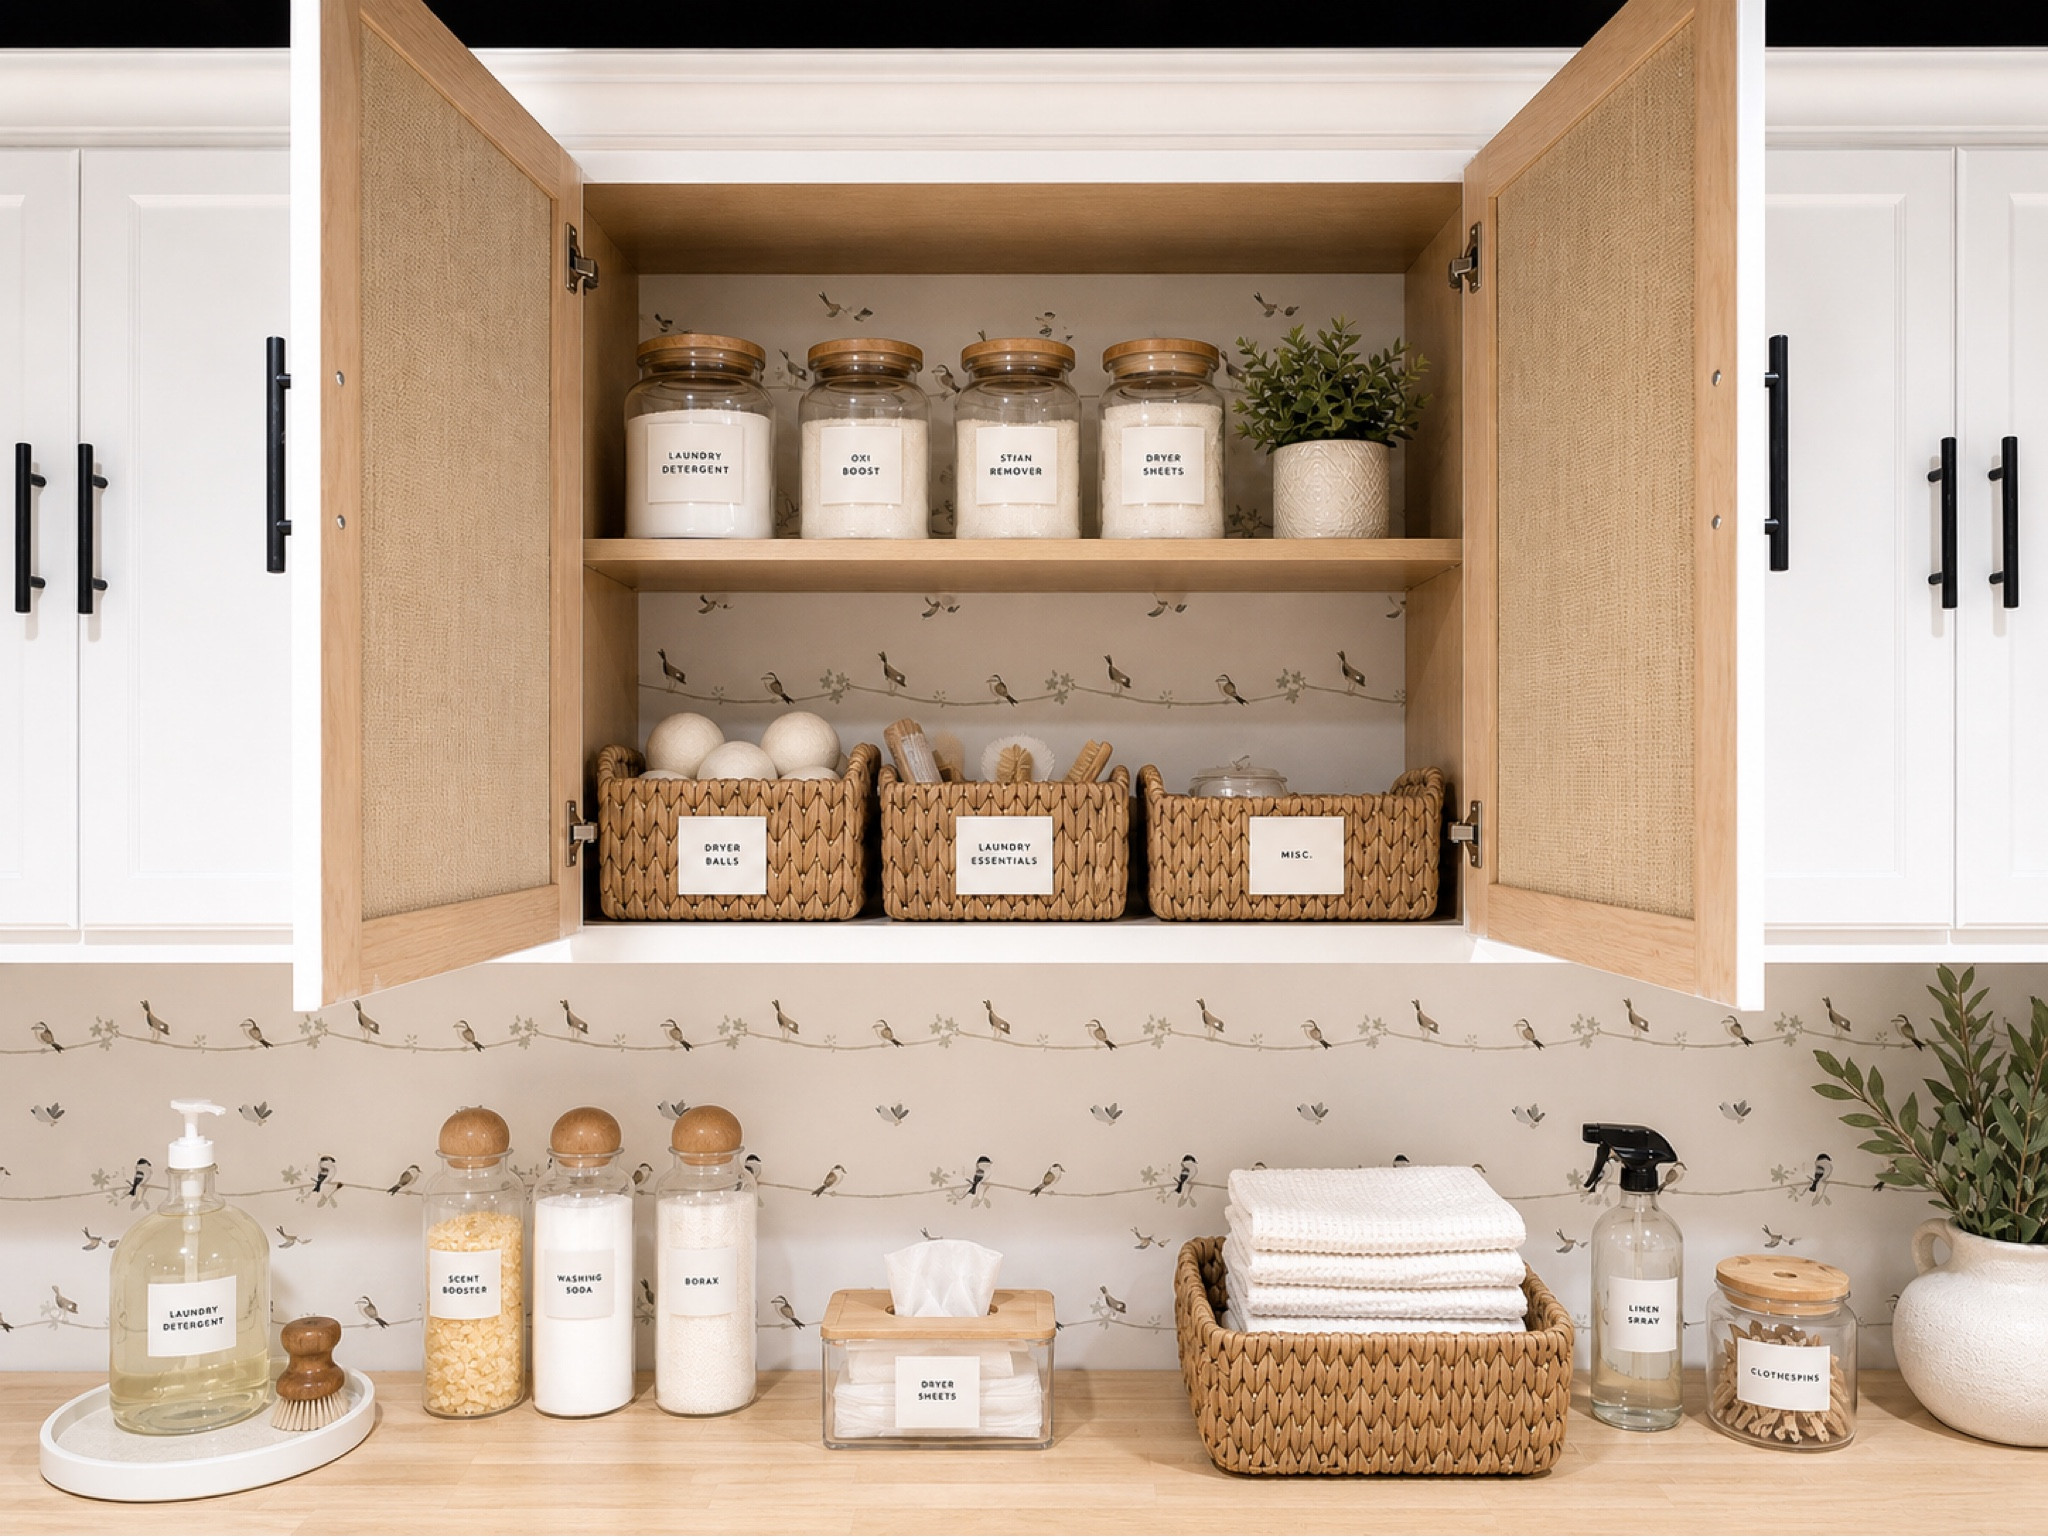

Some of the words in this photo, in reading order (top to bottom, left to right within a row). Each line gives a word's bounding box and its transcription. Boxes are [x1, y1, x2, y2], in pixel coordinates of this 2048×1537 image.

[668, 450, 722, 461] LAUNDRY
[850, 453, 872, 463] OXI
[1000, 453, 1032, 463] STIAN
[1145, 453, 1182, 463] DRYER
[661, 464, 729, 475] DETERGENT
[842, 466, 881, 476] BOOST
[989, 466, 1042, 476] REMOVER
[1143, 466, 1185, 476] SHEETS
[703, 843, 741, 853] DRYER
[978, 842, 1031, 853] LAUNDRY
[1280, 850, 1314, 860] MISC.
[705, 856, 739, 867] BALLS
[970, 856, 1038, 866] ESSENTIALS
[446, 1274, 479, 1284] SCENT
[556, 1273, 603, 1284] WASHING
[684, 1276, 720, 1286] BORAX
[442, 1285, 488, 1295] BOOSTER
[566, 1285, 594, 1295] SODA
[169, 1305, 218, 1318] LAUNDRY
[1628, 1304, 1660, 1314] LINEN
[163, 1317, 224, 1331] DETERGENT
[1750, 1367, 1820, 1382] CLOTHESPINS
[920, 1380, 954, 1390] DRYER
[917, 1392, 957, 1402] SHEETS
